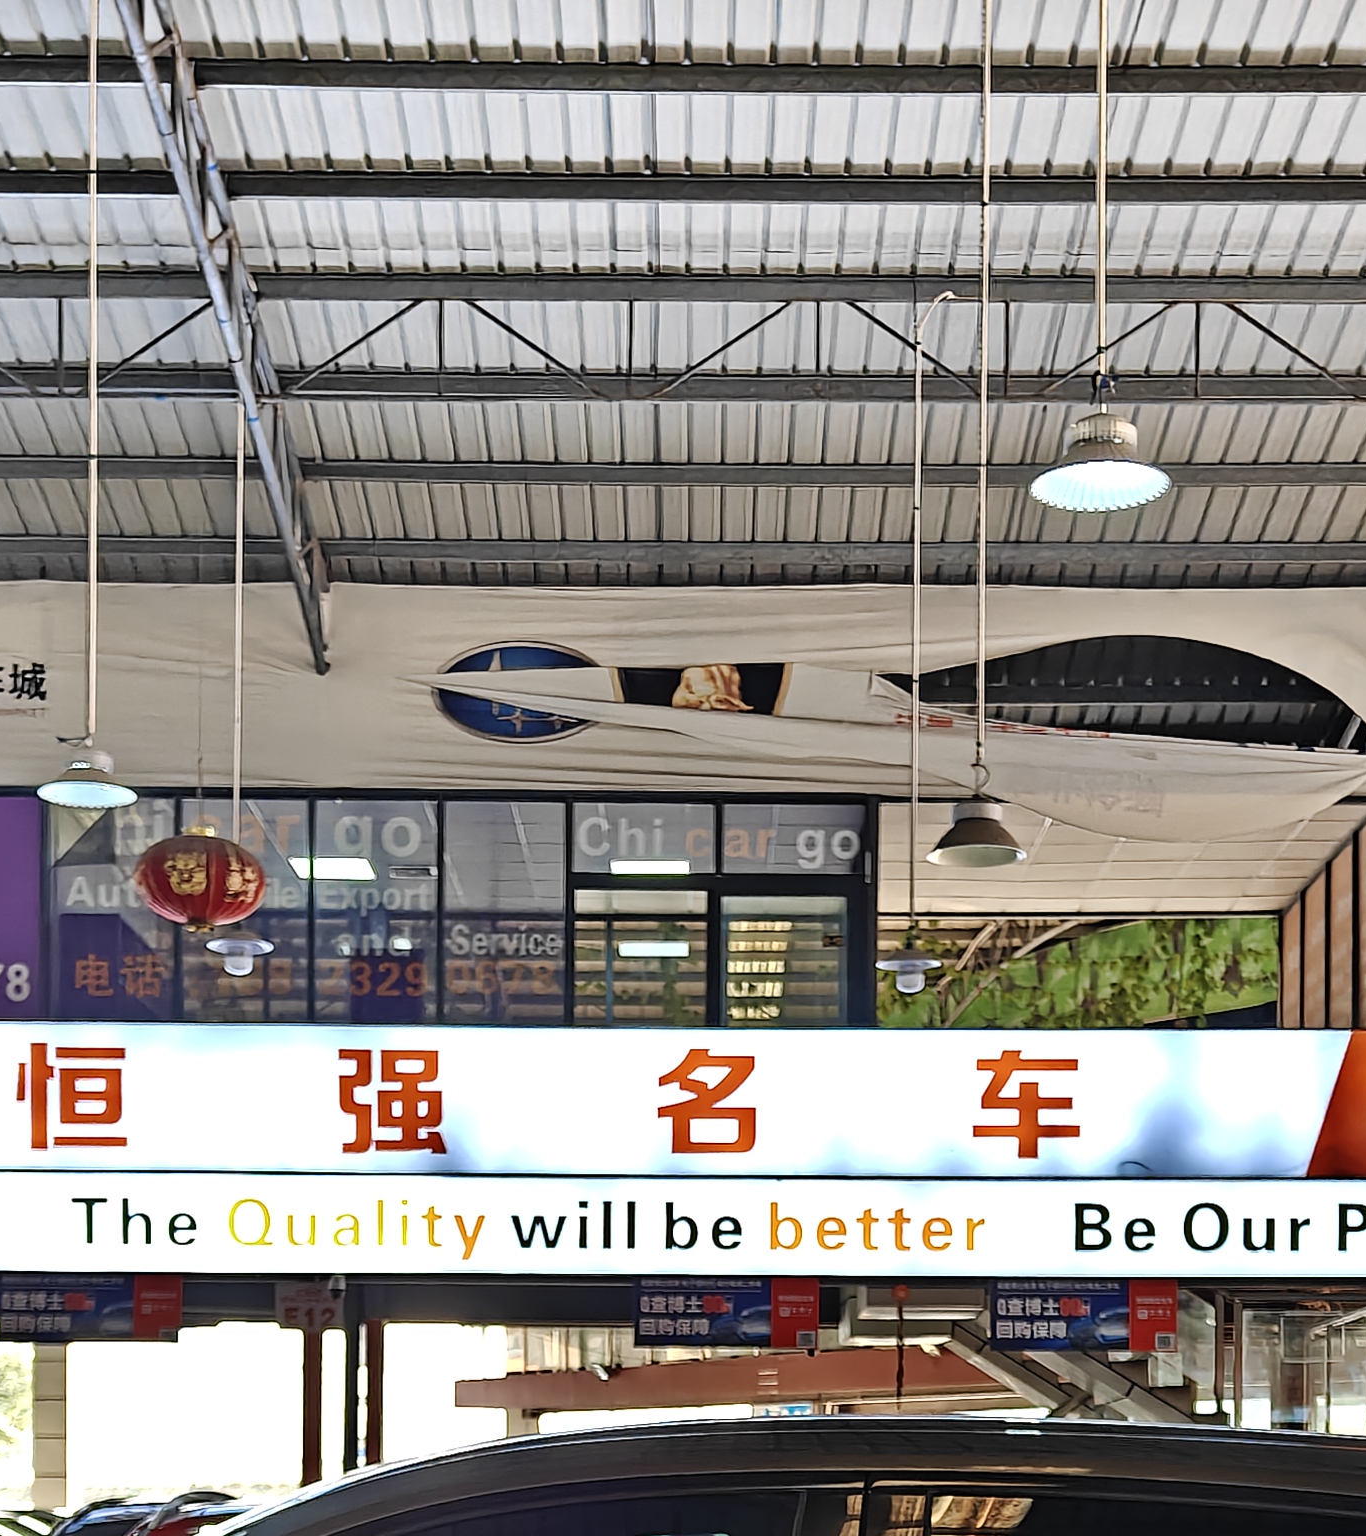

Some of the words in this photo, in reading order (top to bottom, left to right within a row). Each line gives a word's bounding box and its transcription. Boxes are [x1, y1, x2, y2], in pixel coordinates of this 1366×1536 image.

[191, 813, 301, 855] ar
[335, 813, 423, 858] go
[578, 816, 664, 857] Chi
[686, 829, 778, 859] car
[796, 829, 861, 869] go
[322, 885, 434, 916] Export
[451, 924, 562, 957] Service
[74, 953, 167, 998] 电话
[17, 1042, 1081, 1160] 恒强名车
[72, 1198, 196, 1245] The
[229, 1198, 485, 1260] Quality
[511, 1201, 636, 1249] will
[666, 1202, 742, 1250] be
[770, 1202, 985, 1251] better
[1075, 1203, 1155, 1252] Be
[1184, 1203, 1310, 1252] Our
